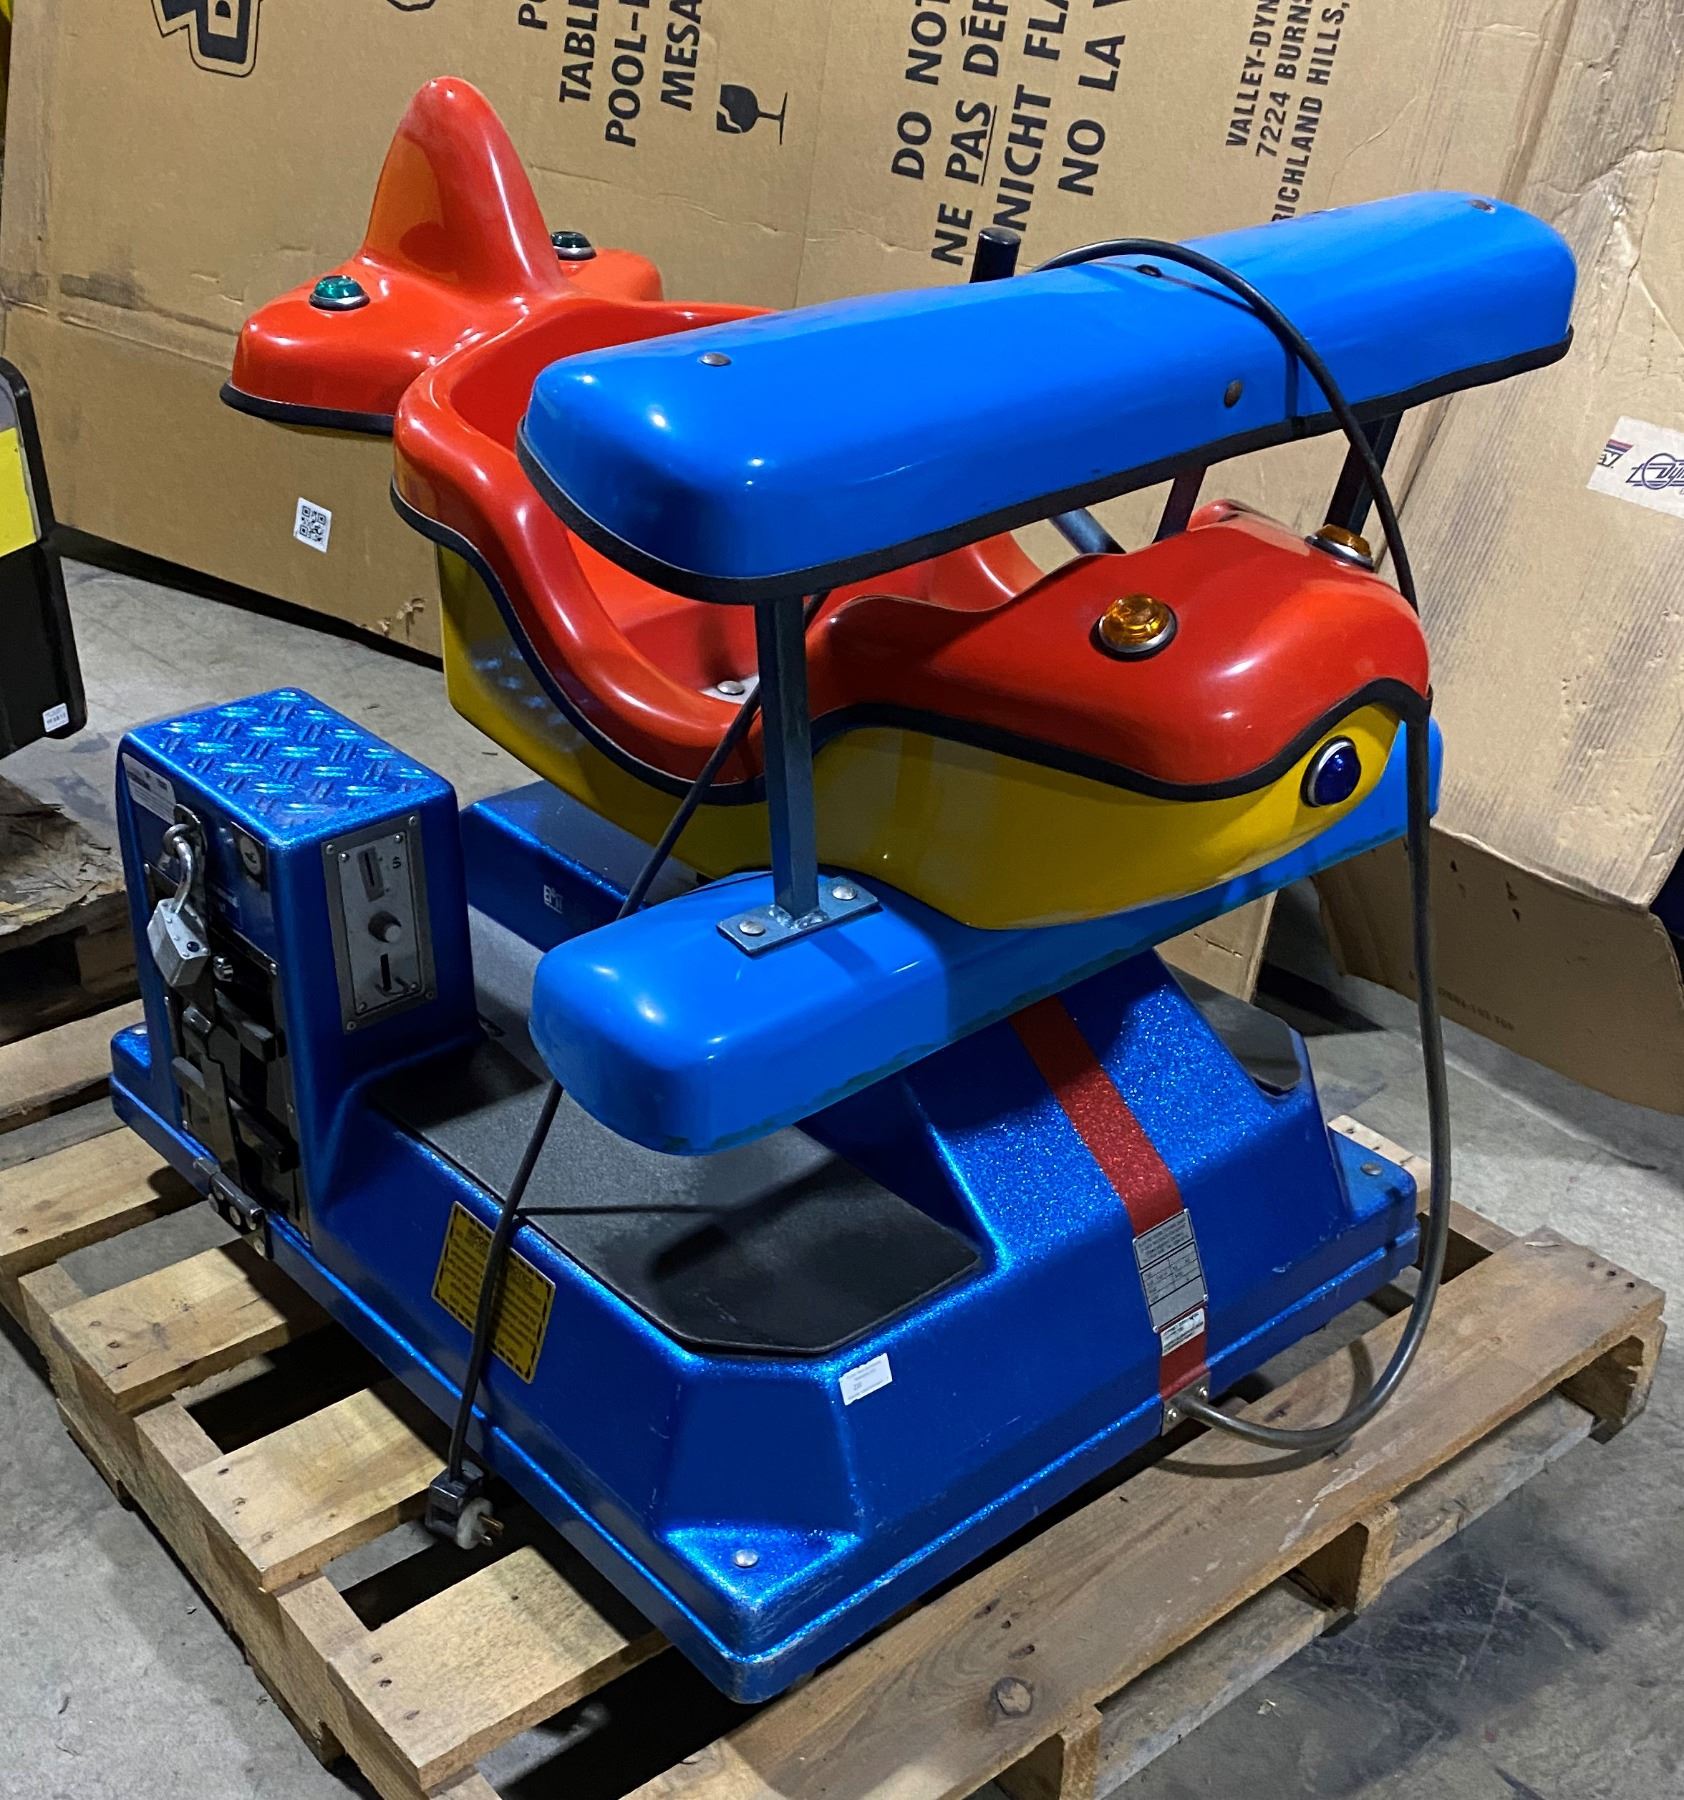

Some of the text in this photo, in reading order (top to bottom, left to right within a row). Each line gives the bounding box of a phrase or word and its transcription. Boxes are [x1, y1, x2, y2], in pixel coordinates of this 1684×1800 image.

[1078, 35, 1126, 91] LA
[1255, 0, 1312, 157] 7224 BURN
[1306, 2, 1350, 86] HILLS,
[891, 111, 932, 180] DO
[944, 99, 992, 184] PAS
[993, 84, 1052, 231] NICHT
[1057, 119, 1106, 196] NO
[931, 203, 973, 265] NE
